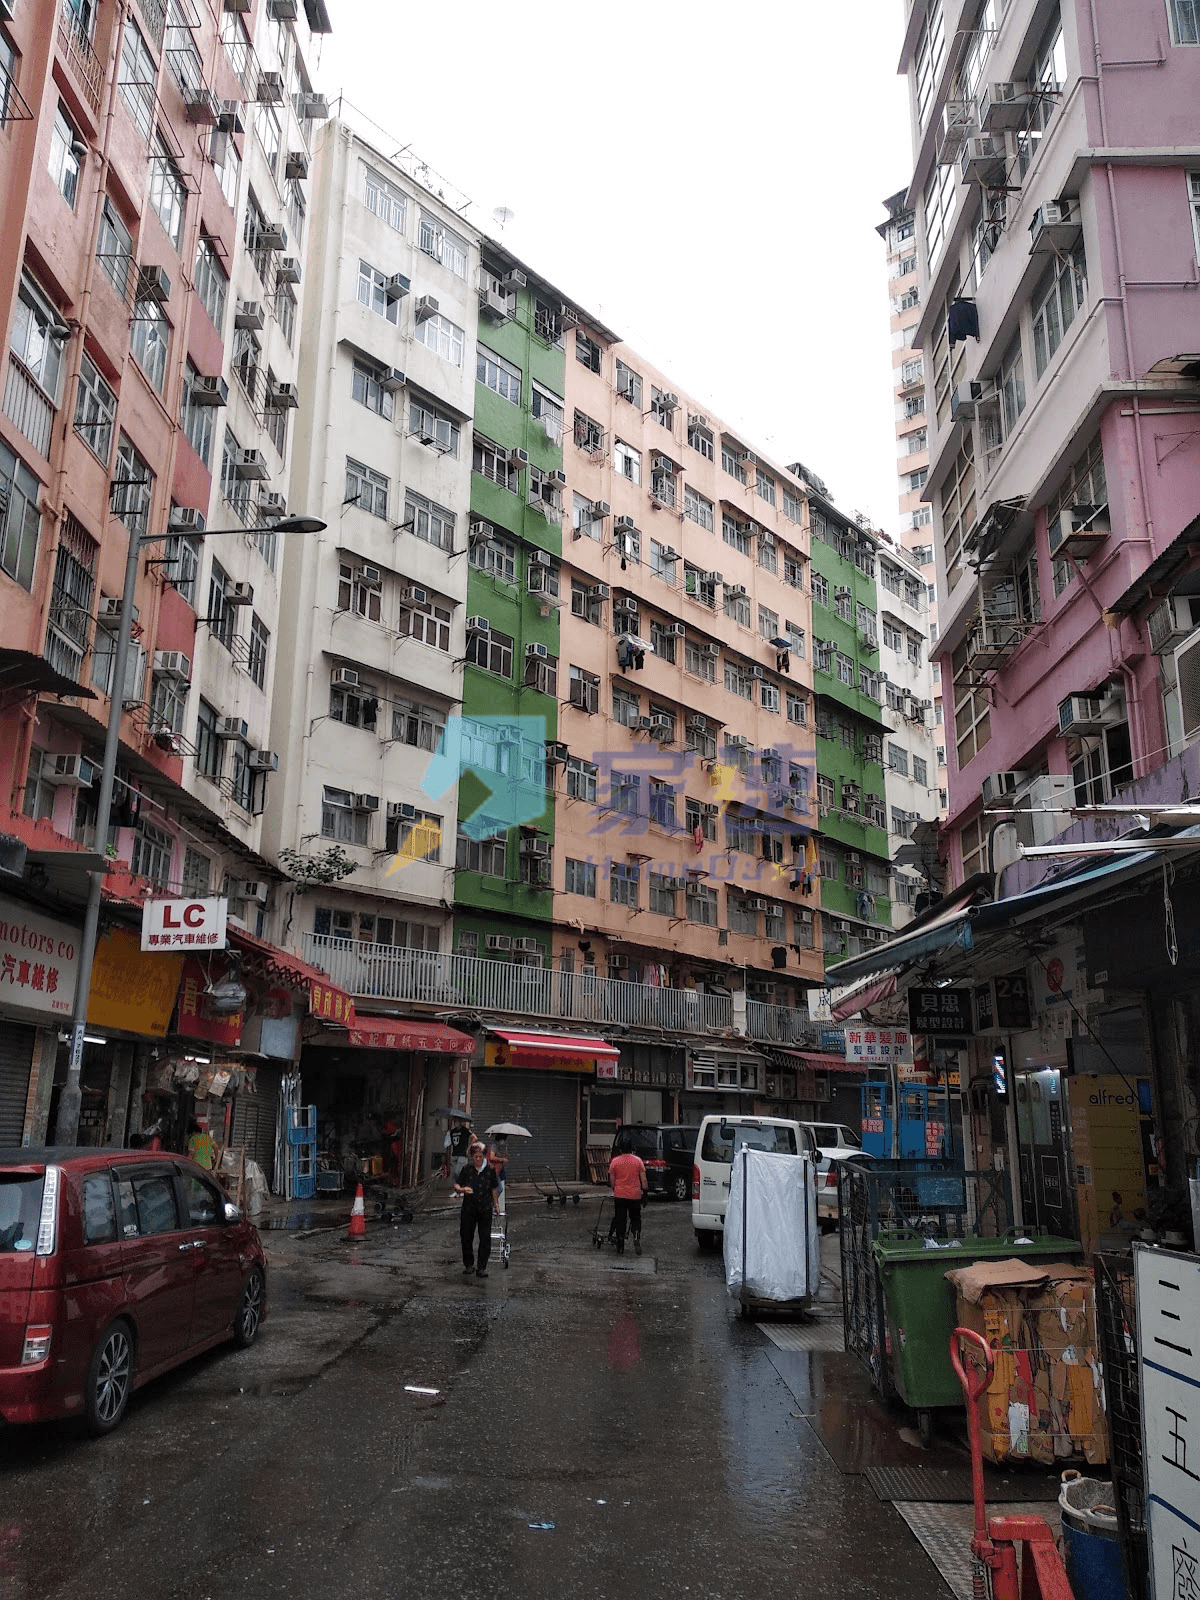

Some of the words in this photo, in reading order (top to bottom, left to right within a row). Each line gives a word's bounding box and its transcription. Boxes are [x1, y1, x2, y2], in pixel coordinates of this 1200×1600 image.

[162, 904, 206, 928] LC
[148, 932, 219, 946] 專業汽車維修
[58, 941, 75, 960] co
[849, 1031, 908, 1044] 新華髮廊
[1089, 1088, 1134, 1105] alfred
